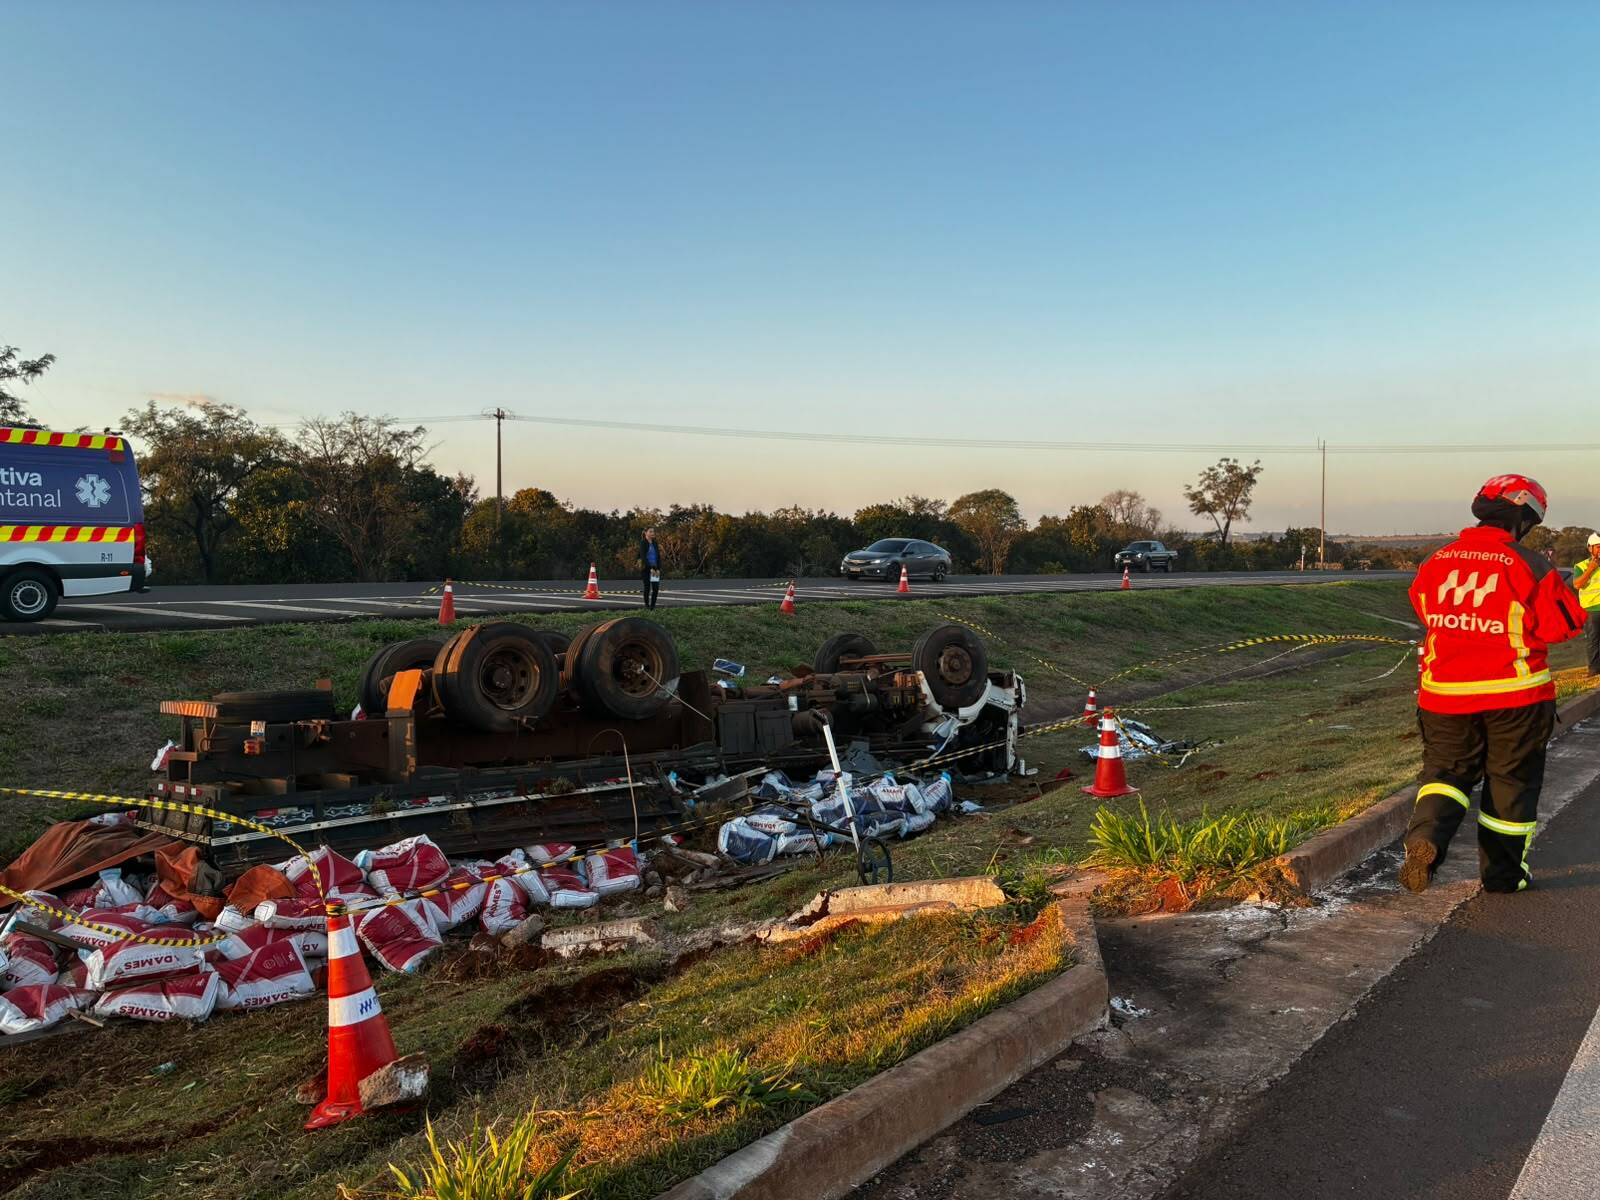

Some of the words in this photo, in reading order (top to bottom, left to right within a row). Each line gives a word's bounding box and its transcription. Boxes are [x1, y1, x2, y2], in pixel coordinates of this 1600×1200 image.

[100, 552, 113, 562] R-11
[1434, 548, 1514, 566] Salvamento
[1427, 612, 1505, 634] motiva
